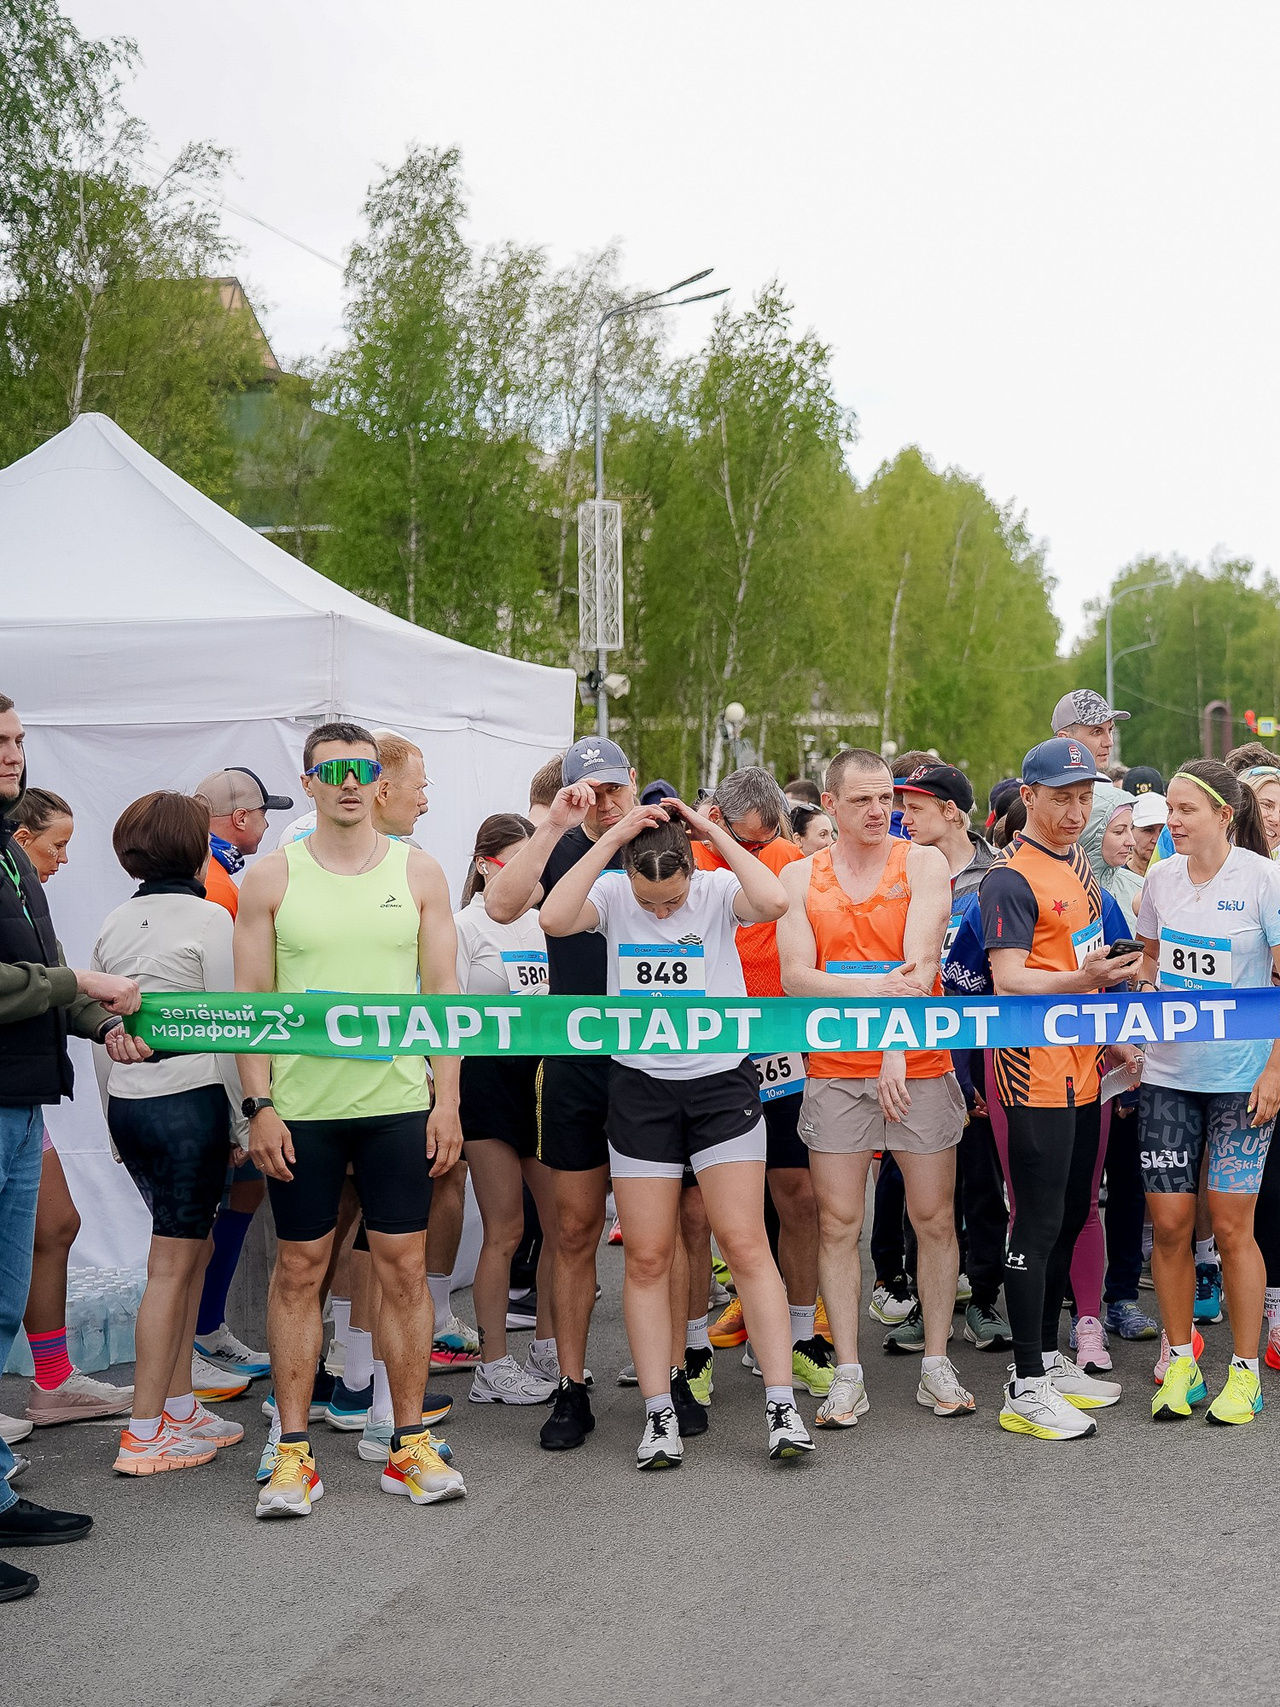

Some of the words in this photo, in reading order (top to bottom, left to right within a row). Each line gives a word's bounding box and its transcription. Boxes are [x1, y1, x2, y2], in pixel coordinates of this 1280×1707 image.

[583, 757, 605, 768] adidas
[636, 961, 688, 985] 848
[1172, 948, 1216, 976] 813
[517, 965, 547, 986] 580
[159, 1003, 257, 1022] зелёный
[1043, 999, 1237, 1045] СТАРТ
[151, 1022, 250, 1041] марафон
[325, 1005, 522, 1049] СТАРТ
[567, 1007, 762, 1050] СТАРТ
[805, 1006, 1000, 1050] СТАРТ
